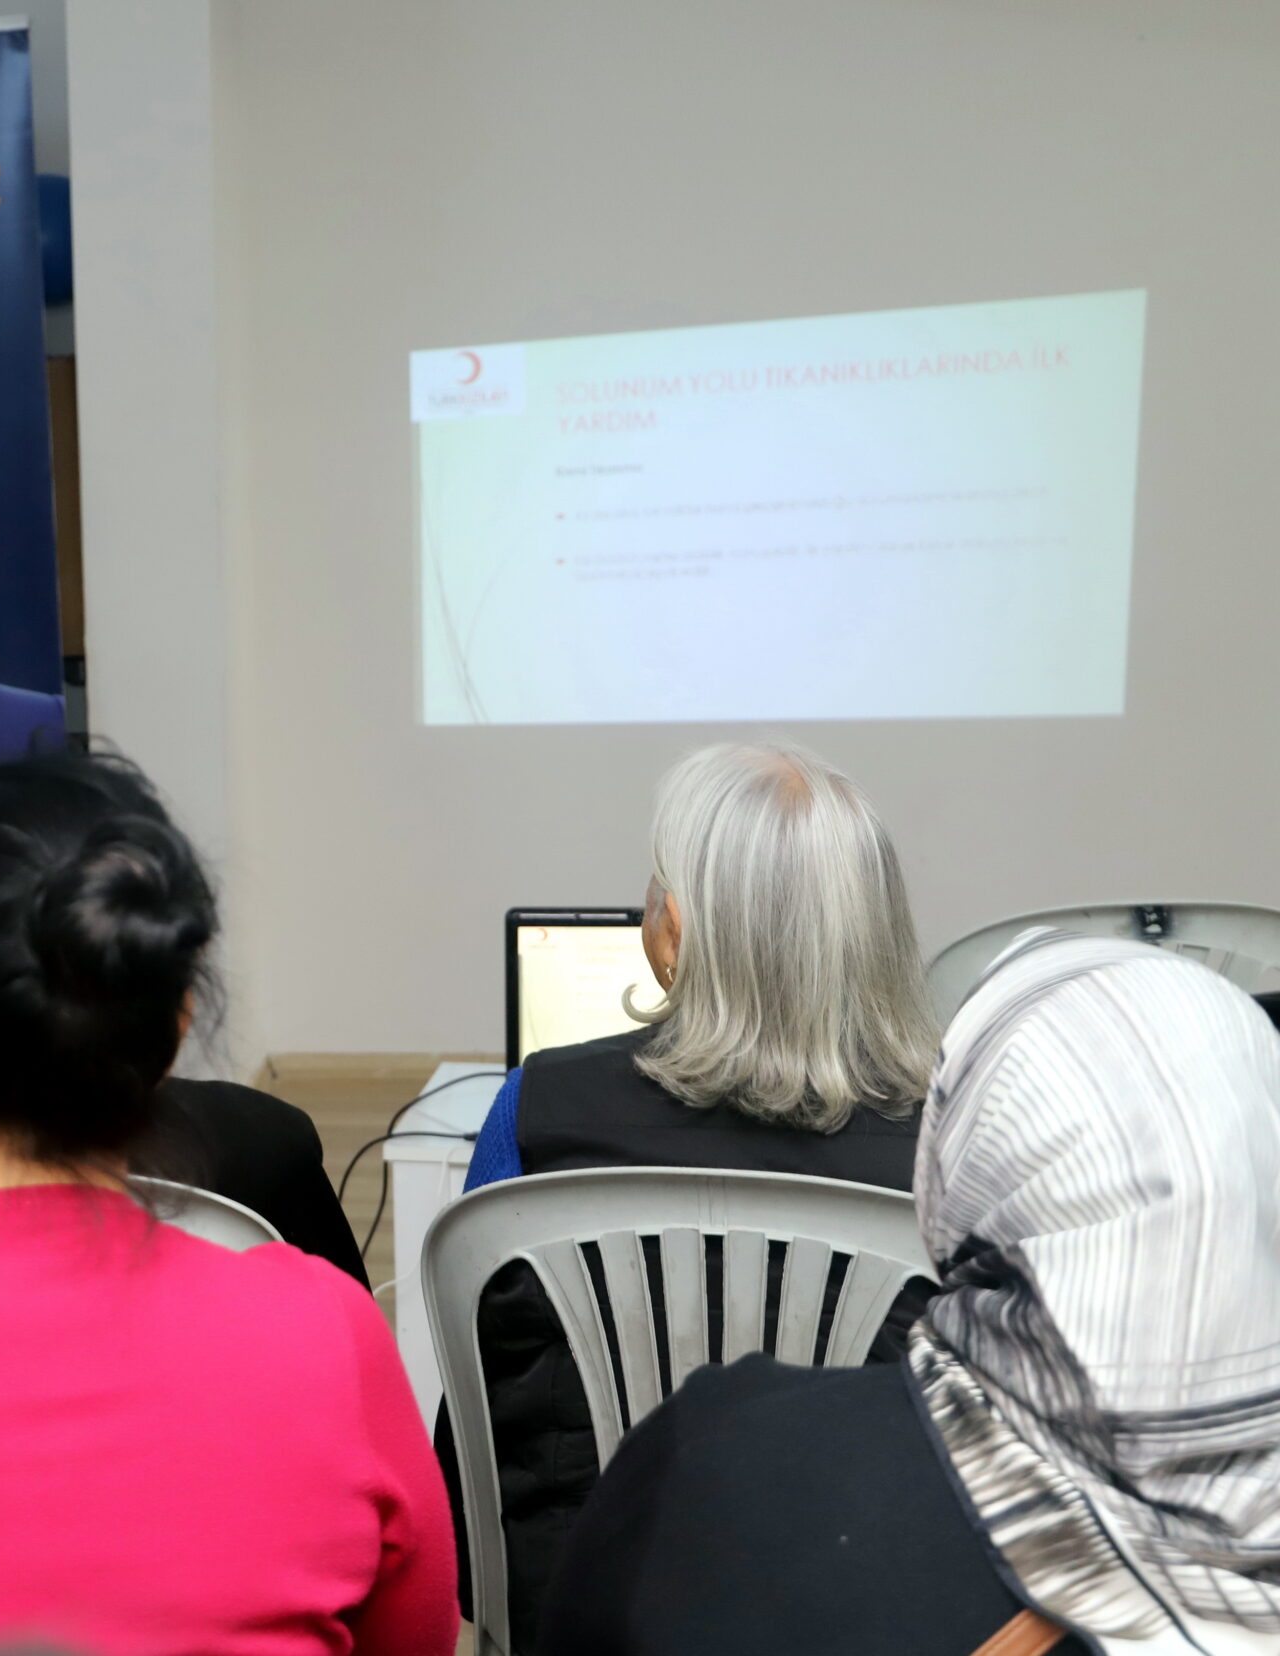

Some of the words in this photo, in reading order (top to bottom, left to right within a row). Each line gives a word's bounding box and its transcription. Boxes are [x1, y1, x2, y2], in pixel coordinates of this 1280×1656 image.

[556, 374, 683, 406] SOLUNUM
[687, 366, 759, 395] YOLU
[556, 409, 658, 434] YARDIM
